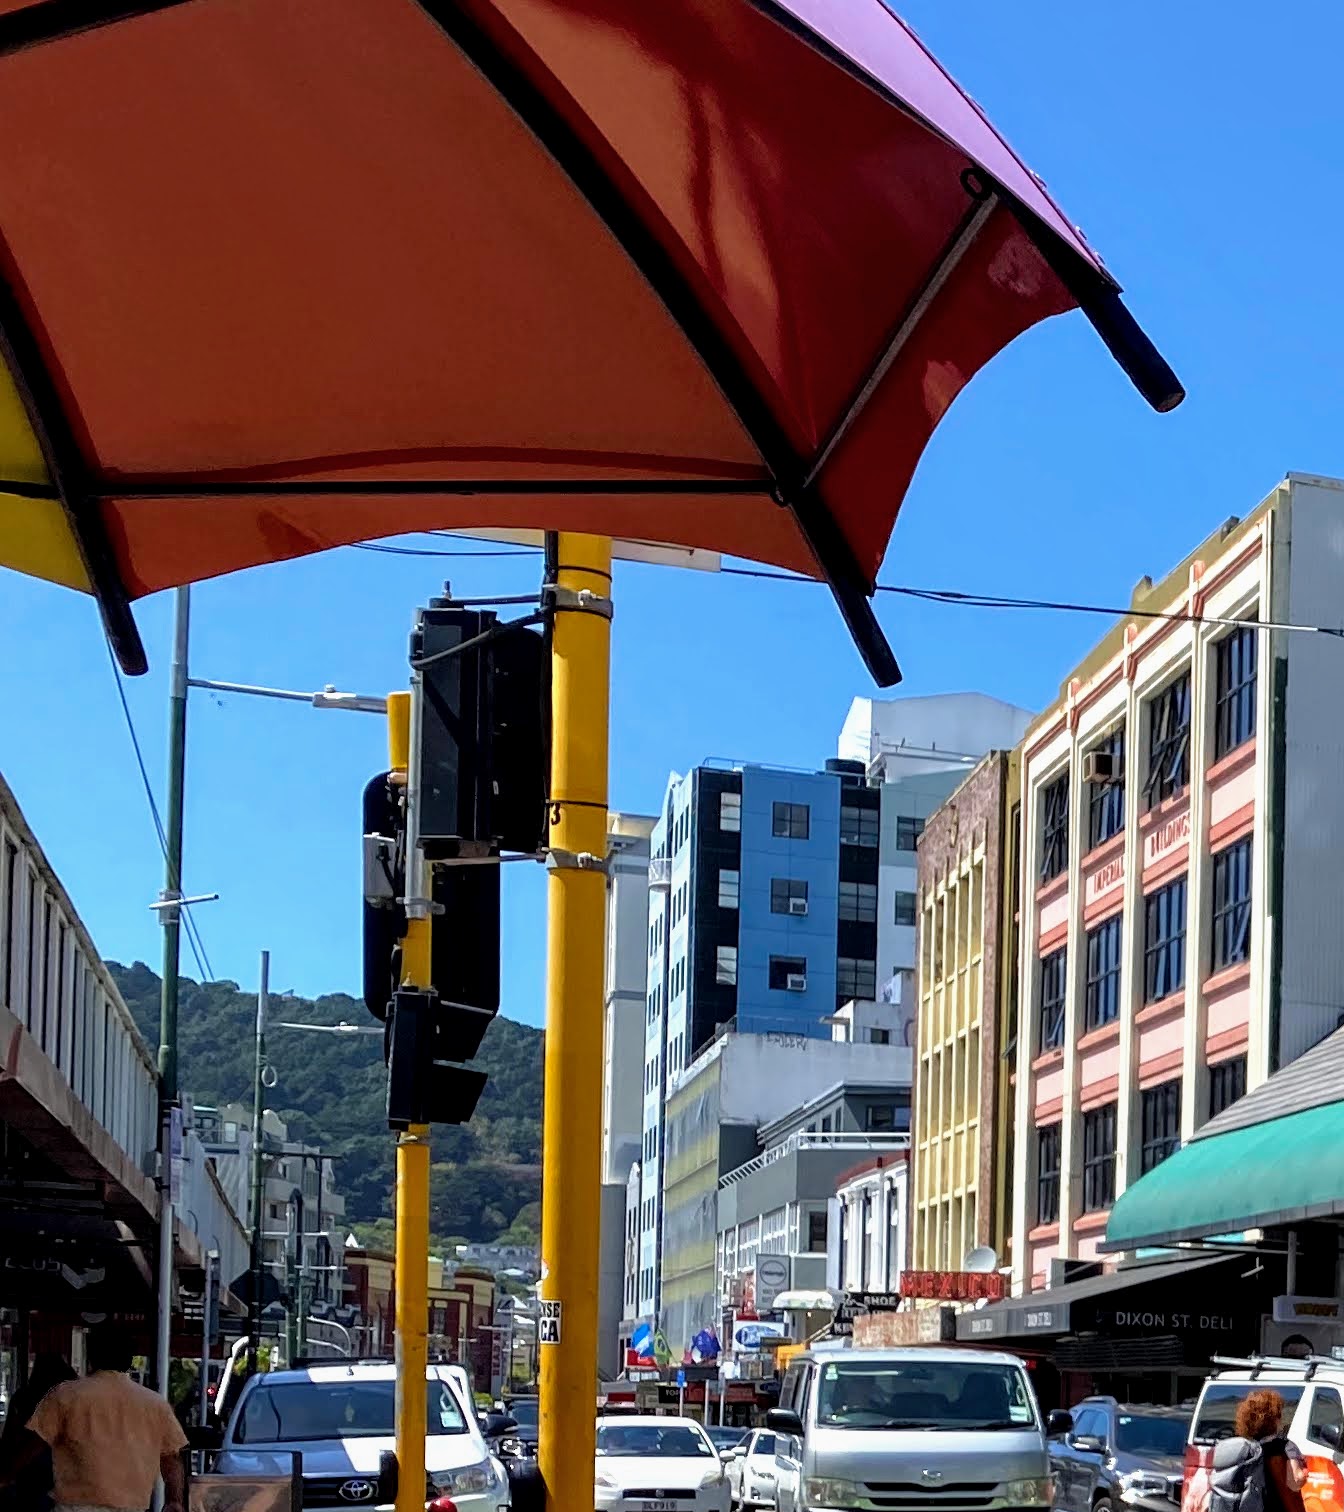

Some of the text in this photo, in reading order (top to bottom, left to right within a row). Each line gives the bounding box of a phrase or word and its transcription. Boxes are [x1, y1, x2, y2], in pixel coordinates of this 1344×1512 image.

[901, 1272, 1001, 1300] MEXICO
[864, 1295, 897, 1306] SHOE
[1115, 1311, 1233, 1330] DIXON ST. DELI
